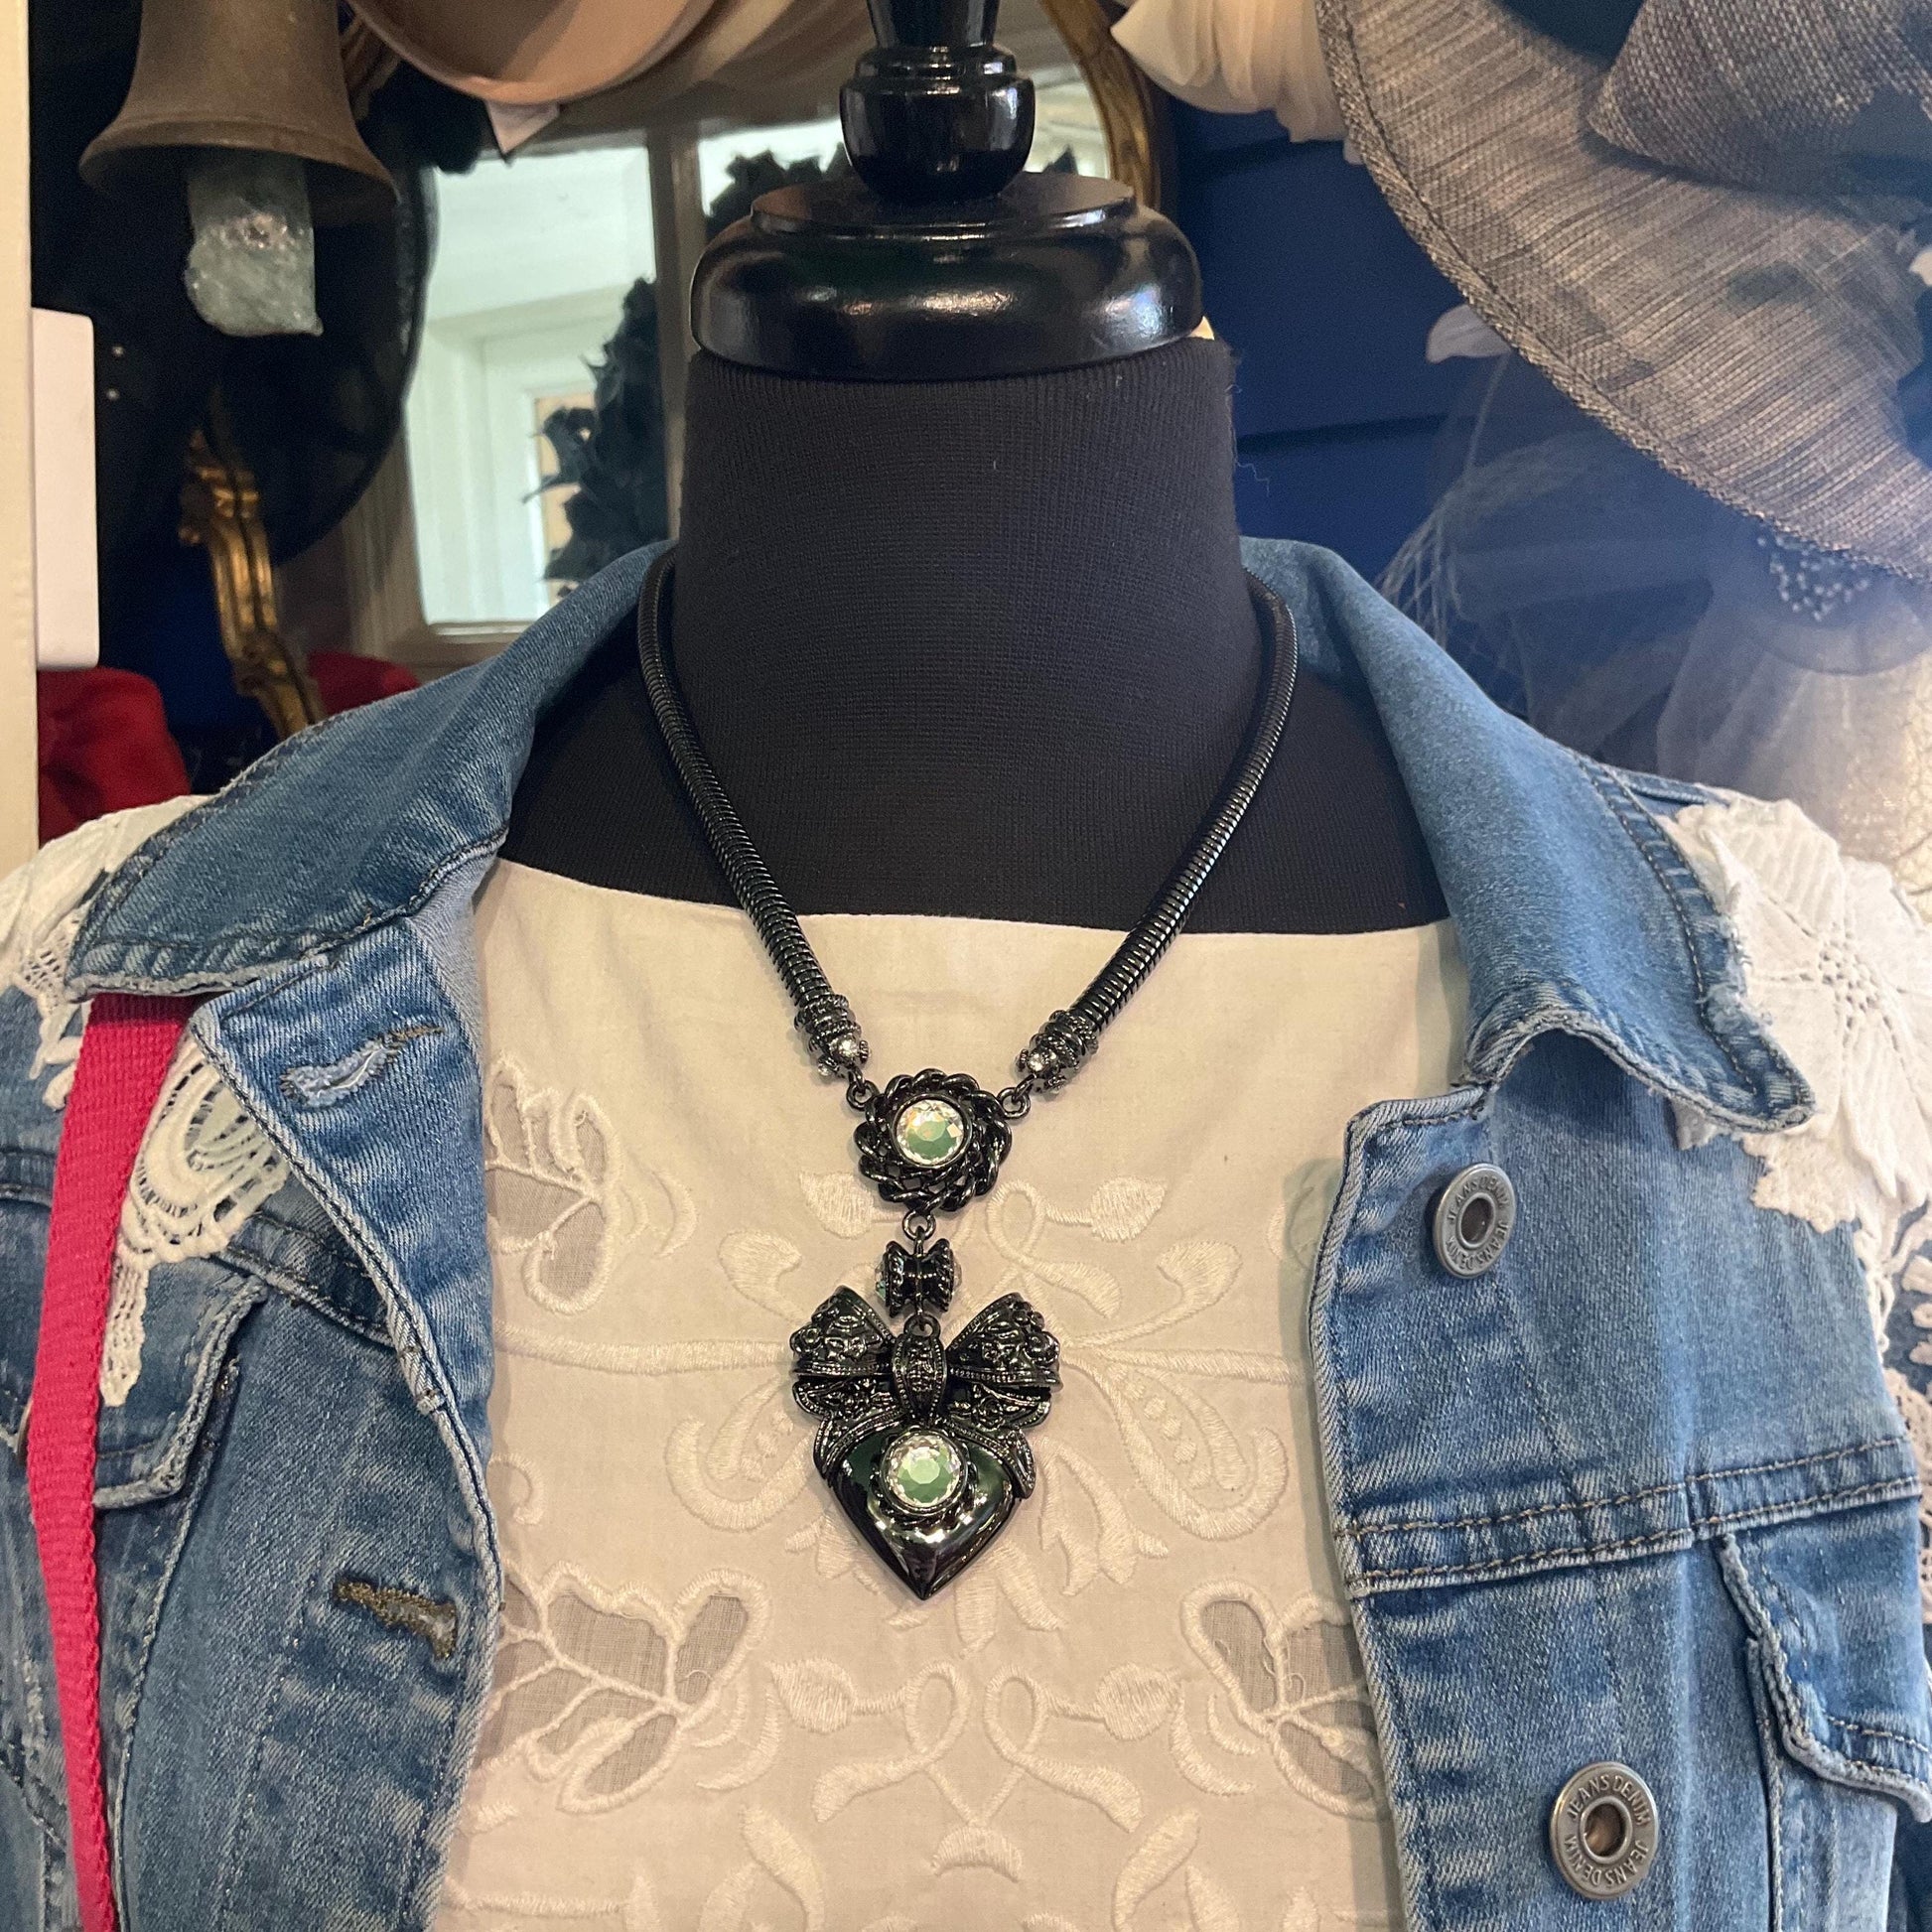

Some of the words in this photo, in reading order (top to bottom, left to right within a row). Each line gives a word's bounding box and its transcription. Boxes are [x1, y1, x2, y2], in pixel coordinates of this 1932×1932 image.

[1567, 1774, 1609, 1821] JEANS
[1612, 1775, 1651, 1826] DENIM
[1565, 1834, 1601, 1886] DENIM
[1604, 1840, 1649, 1887] JEANS
